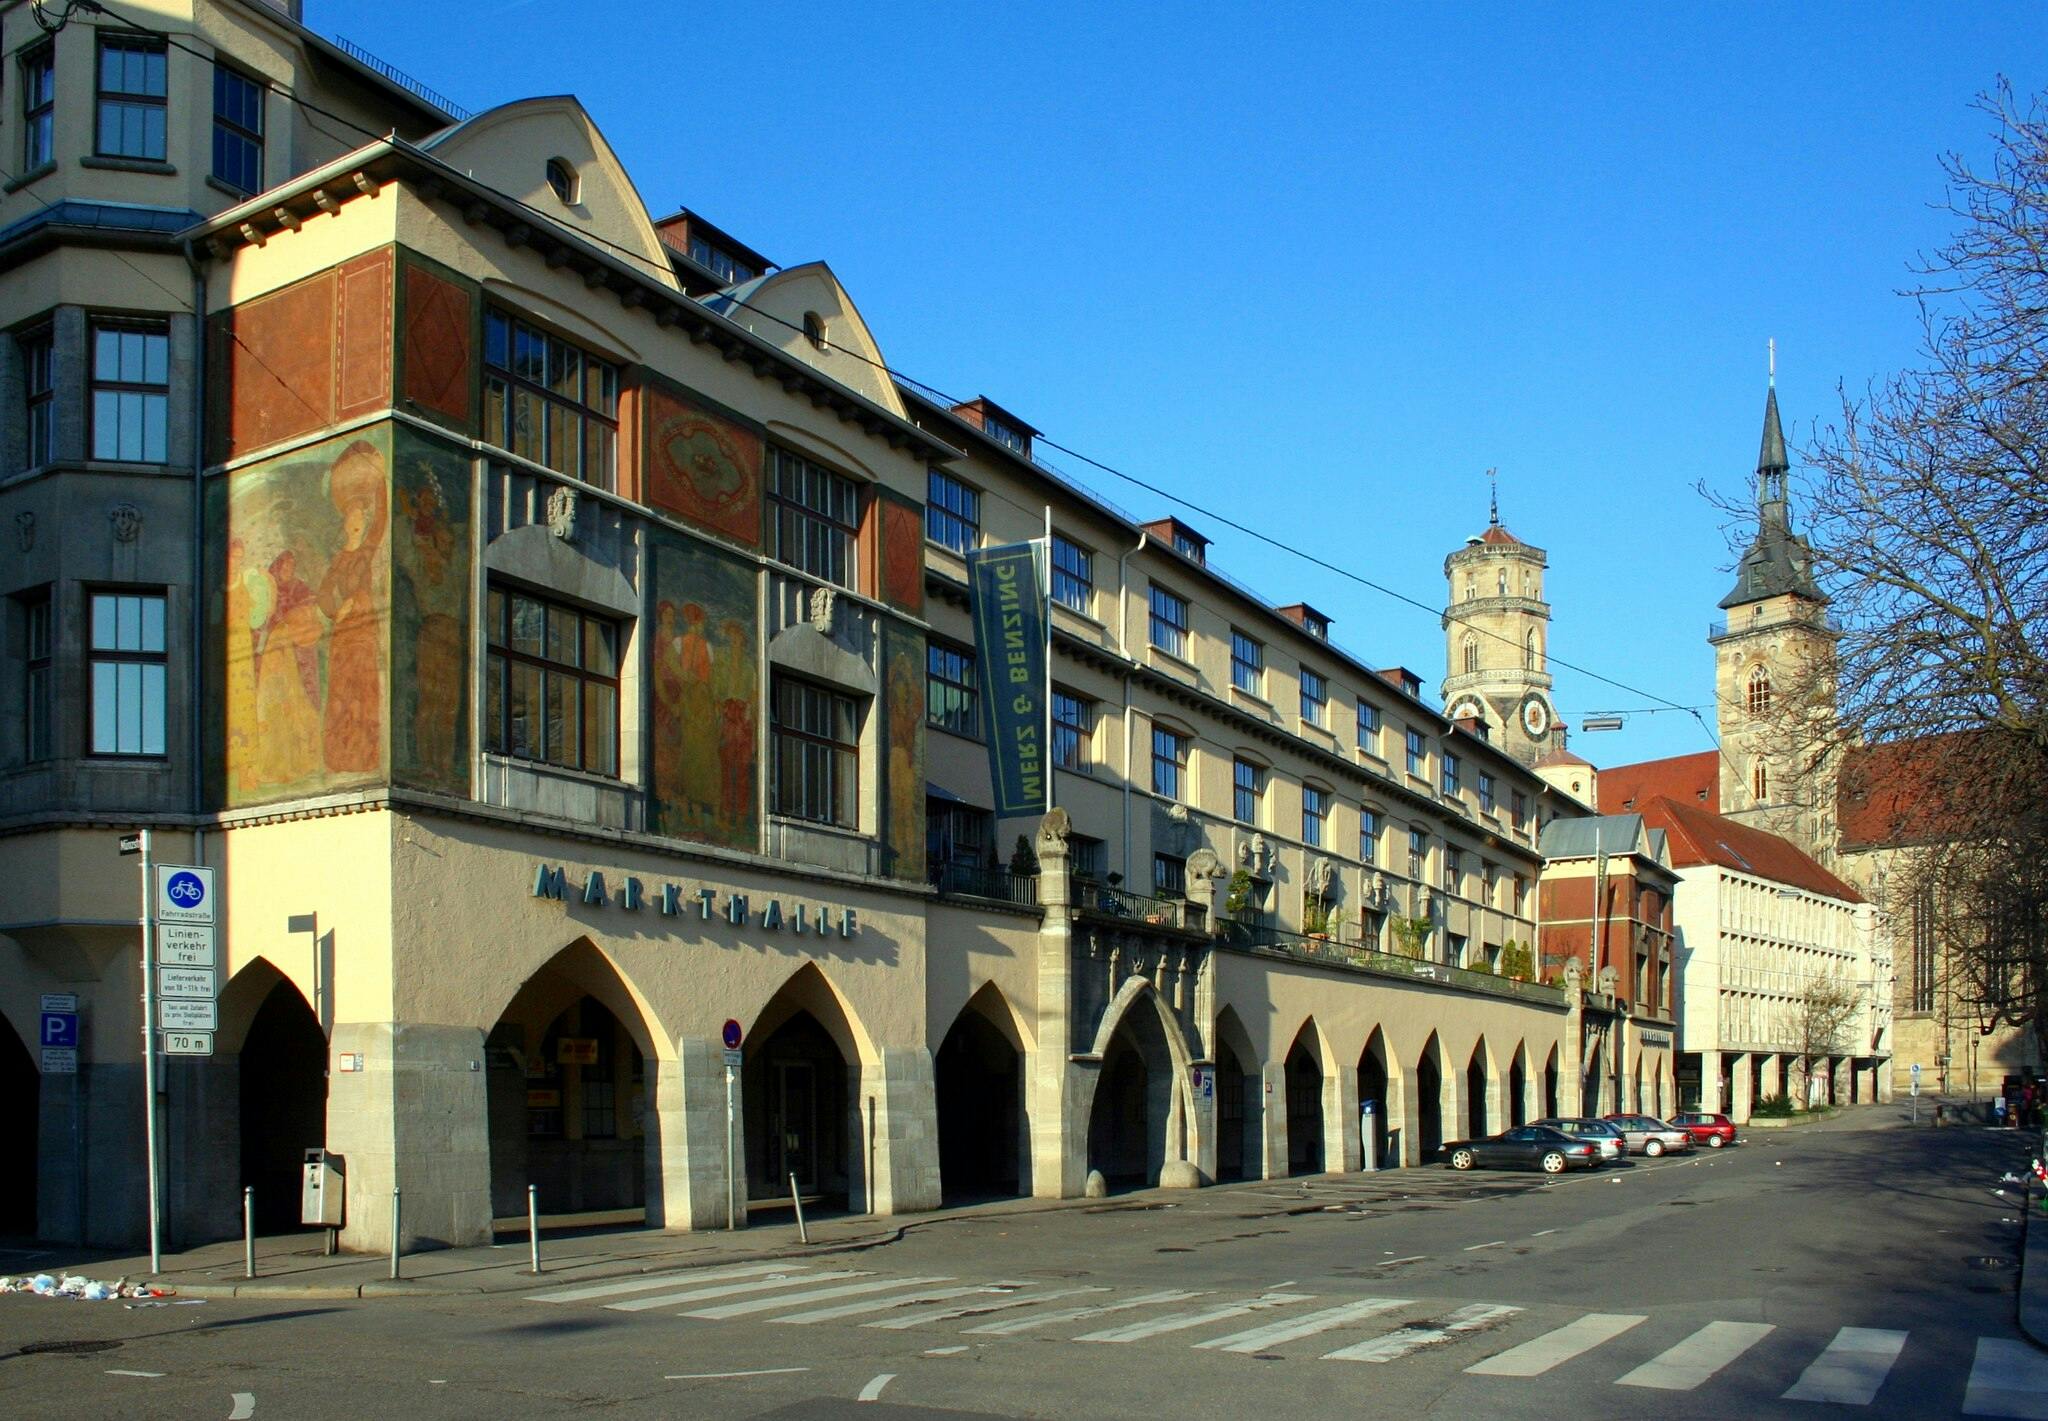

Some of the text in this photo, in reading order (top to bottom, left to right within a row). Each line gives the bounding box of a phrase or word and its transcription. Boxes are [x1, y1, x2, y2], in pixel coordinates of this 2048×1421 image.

[533, 863, 857, 937] MARKTHALLE
[161, 909, 211, 919] Fahrradstraße
[168, 928, 204, 938] Linien-
[166, 940, 207, 951] verkehr
[178, 952, 196, 961] frei
[46, 1017, 67, 1042] P
[174, 1037, 203, 1048] 70 m
